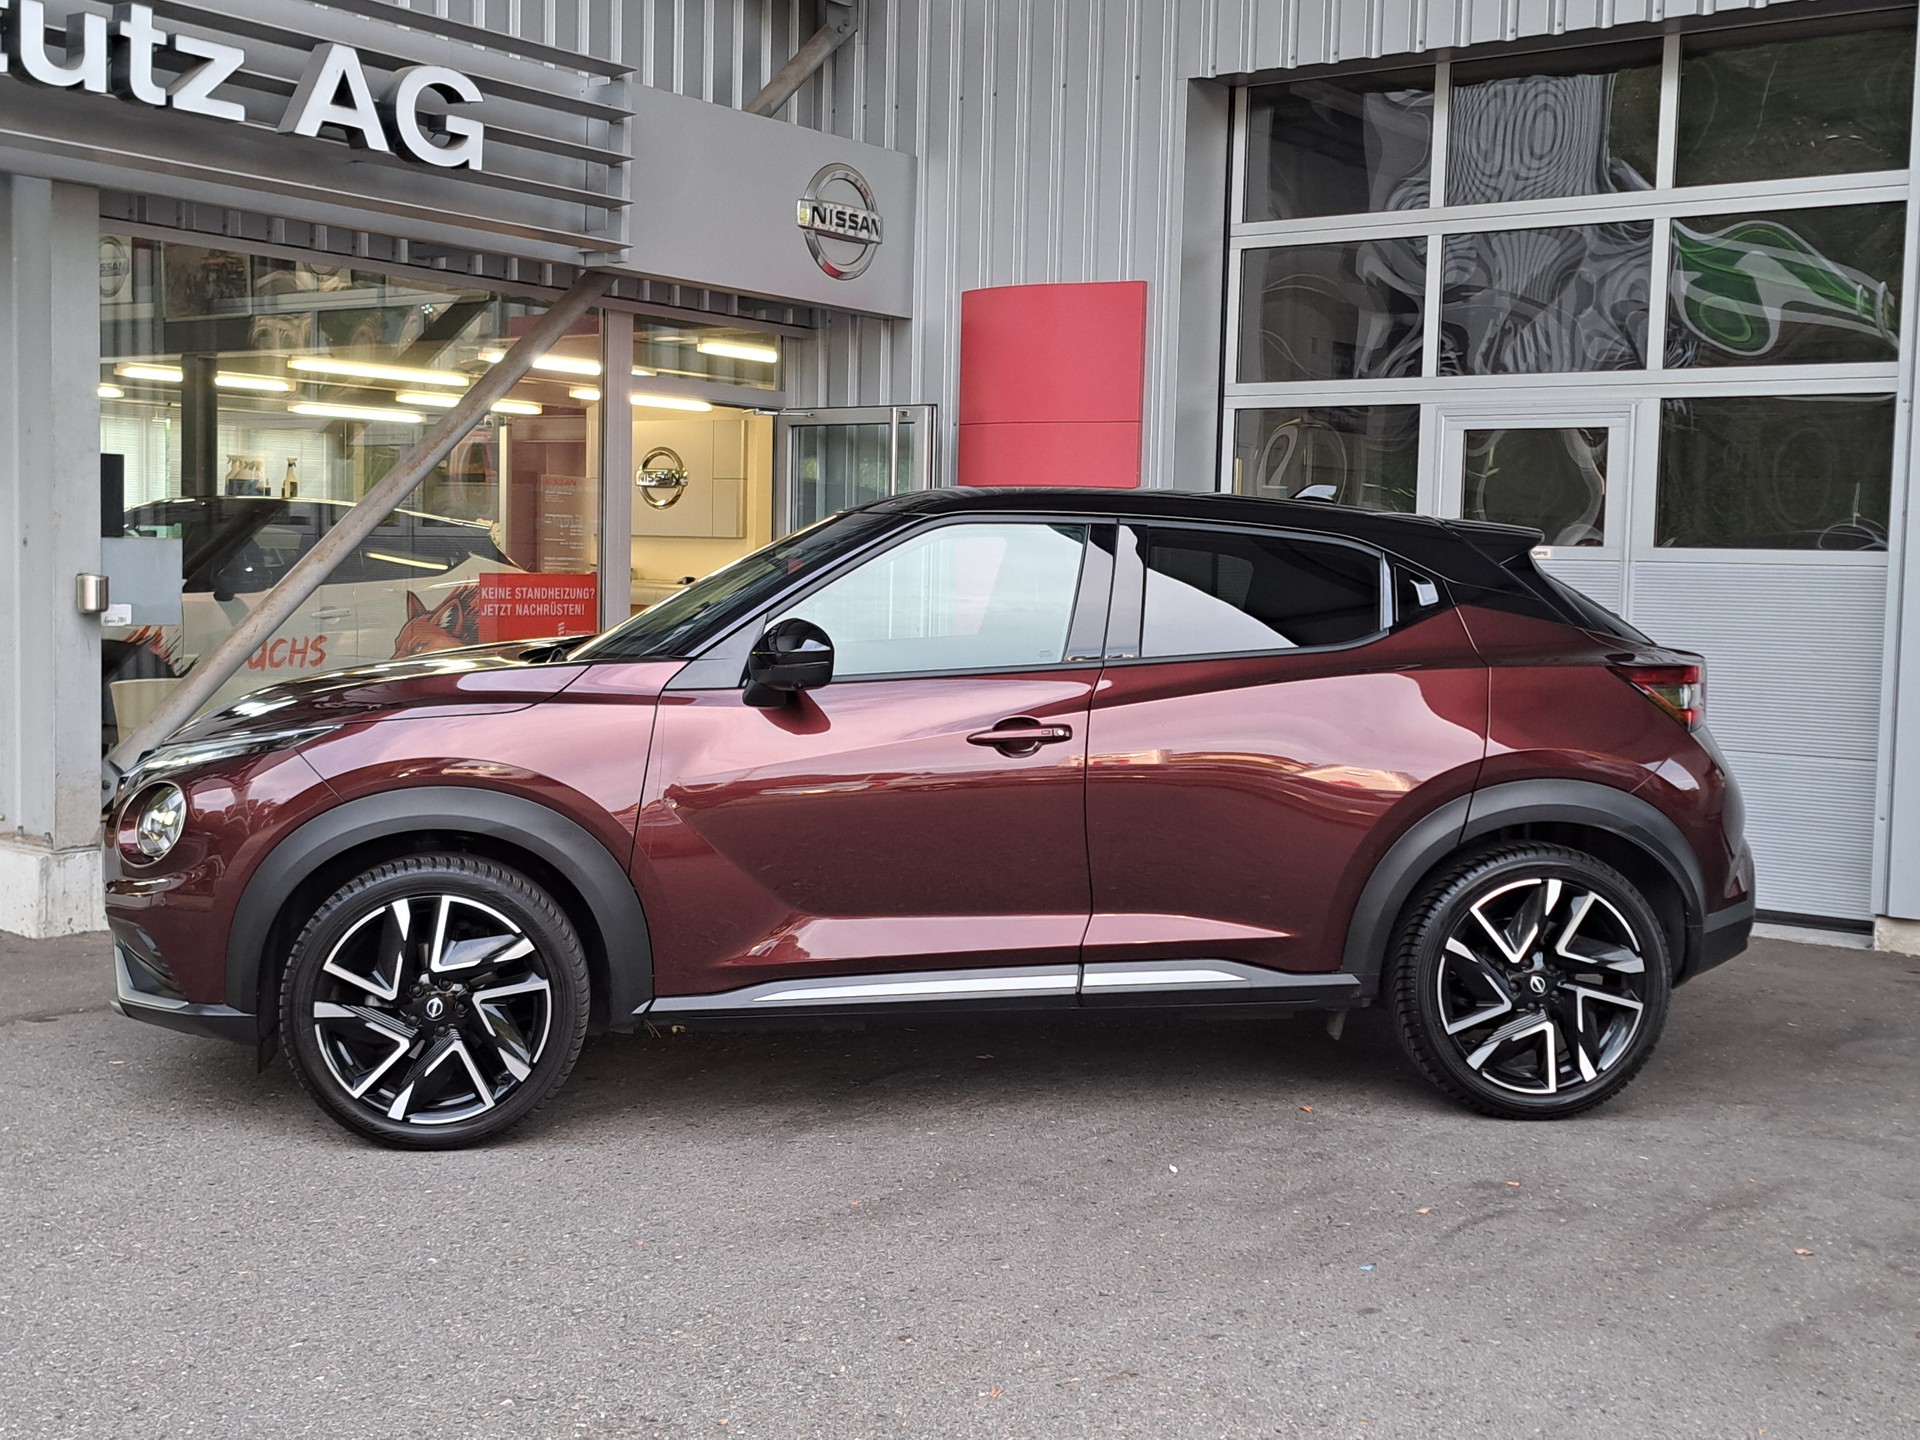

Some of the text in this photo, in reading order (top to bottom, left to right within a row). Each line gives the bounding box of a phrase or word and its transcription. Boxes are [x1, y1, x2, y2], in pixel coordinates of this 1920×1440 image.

[0, 0, 485, 171] utz AG
[811, 205, 880, 237] NISSAN
[481, 587, 596, 600] KEINE STANDHEIZUNG?
[481, 601, 585, 616] JETZT NACHRÜSTEN!
[247, 634, 328, 672] UCHS
